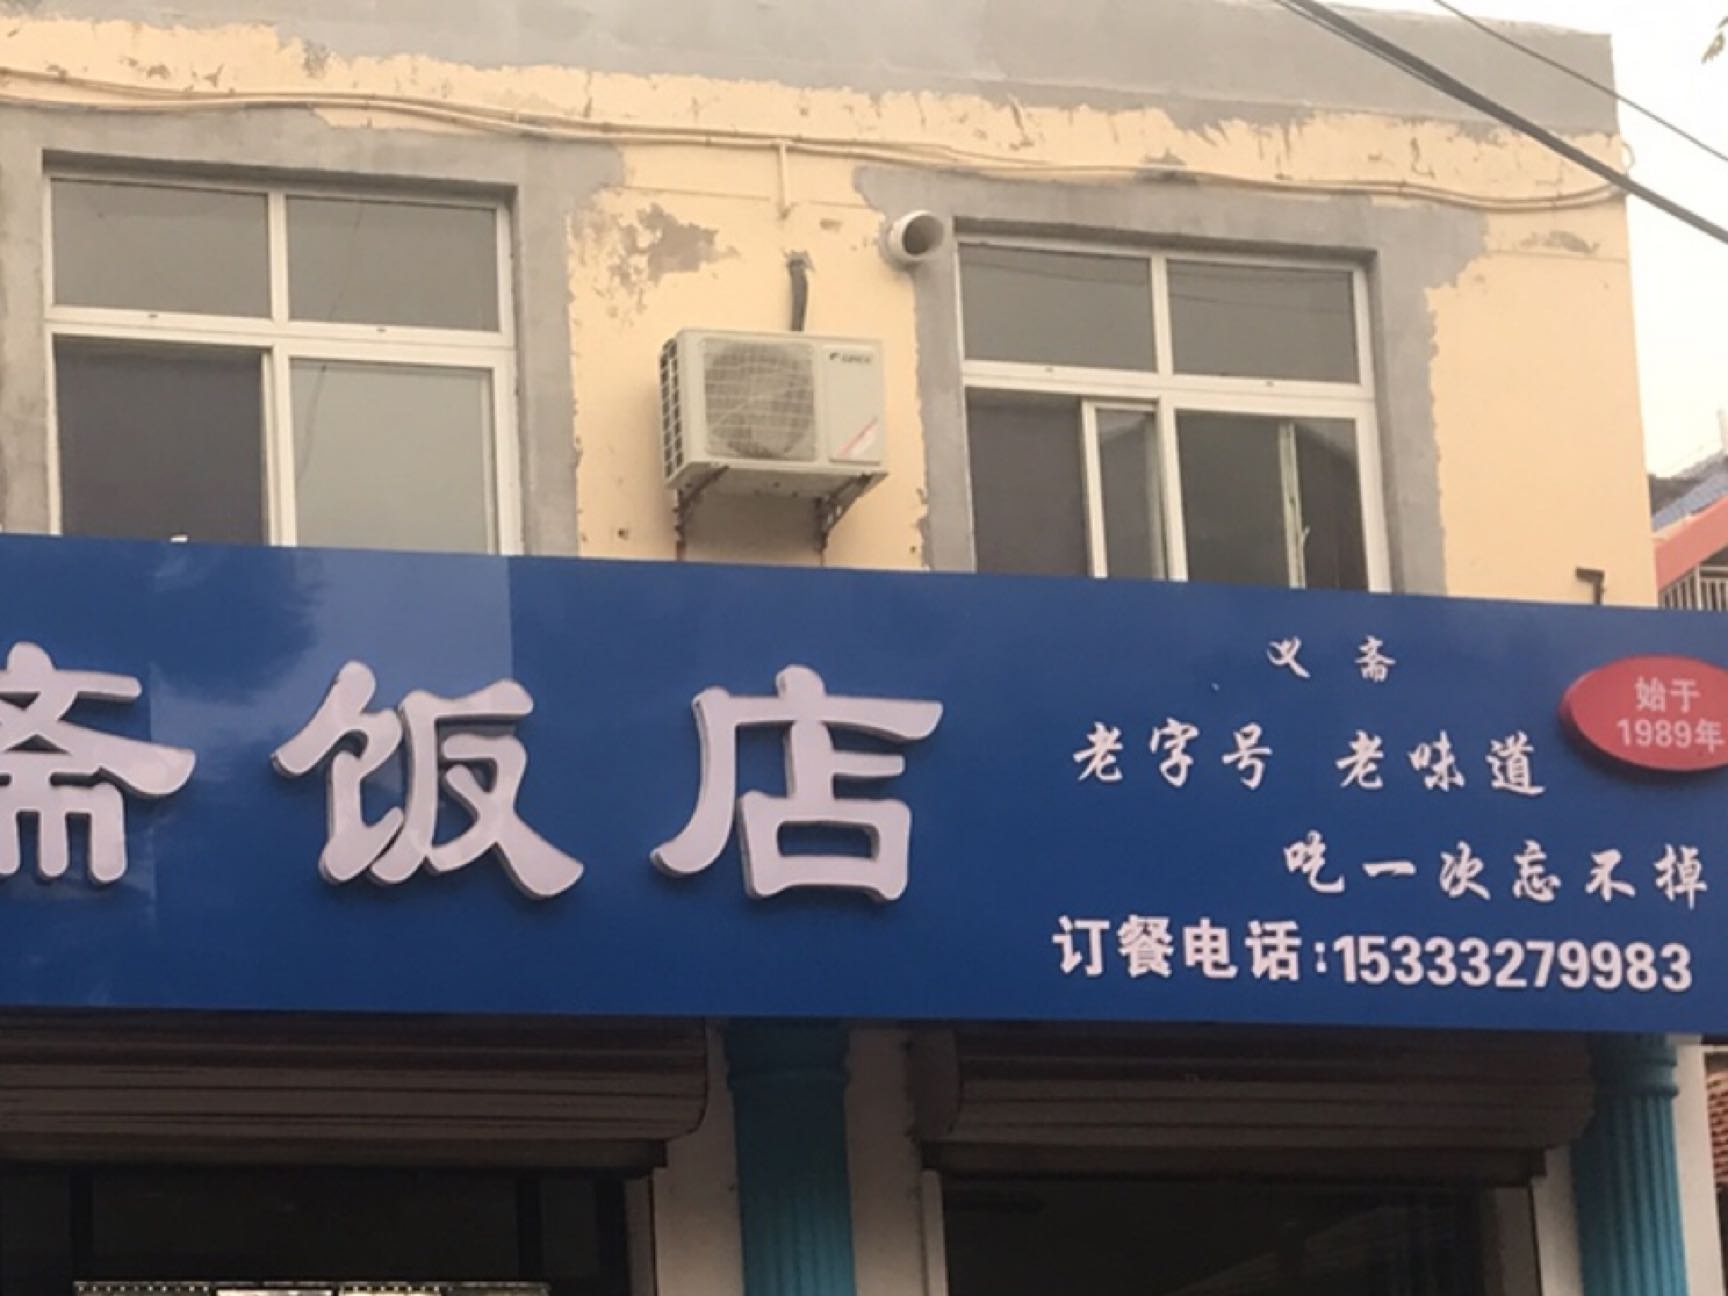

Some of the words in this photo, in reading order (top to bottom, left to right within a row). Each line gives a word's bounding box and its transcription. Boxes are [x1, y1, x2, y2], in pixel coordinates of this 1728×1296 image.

[1073, 717, 1272, 790] 老字号
[1335, 730, 1544, 795] 老味道
[1617, 718, 1724, 753] 1989年
[1283, 830, 1708, 909] 吃一次忘不掉
